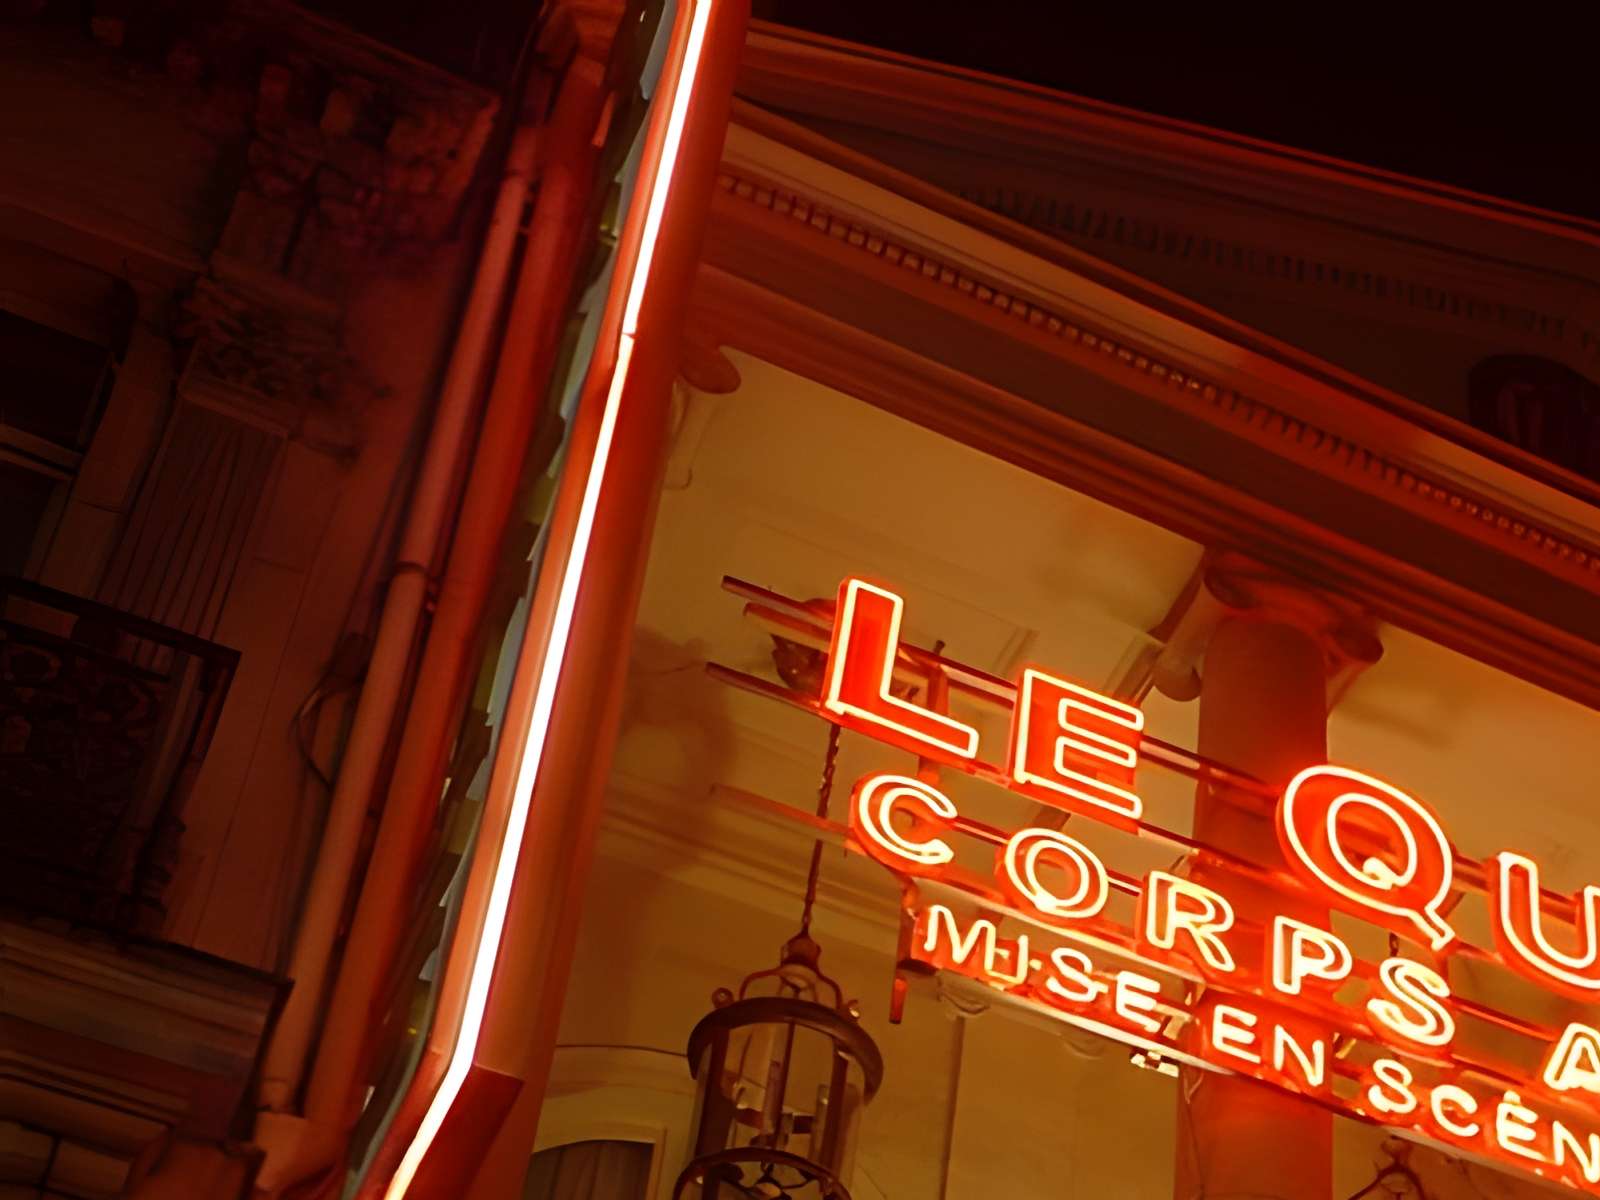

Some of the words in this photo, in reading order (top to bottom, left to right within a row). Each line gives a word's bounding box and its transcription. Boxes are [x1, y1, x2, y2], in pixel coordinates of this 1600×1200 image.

[822, 576, 1145, 822] LE
[856, 773, 1456, 1047] CORPS
[923, 904, 1161, 1033] MISE
[1211, 1003, 1325, 1087] EN
